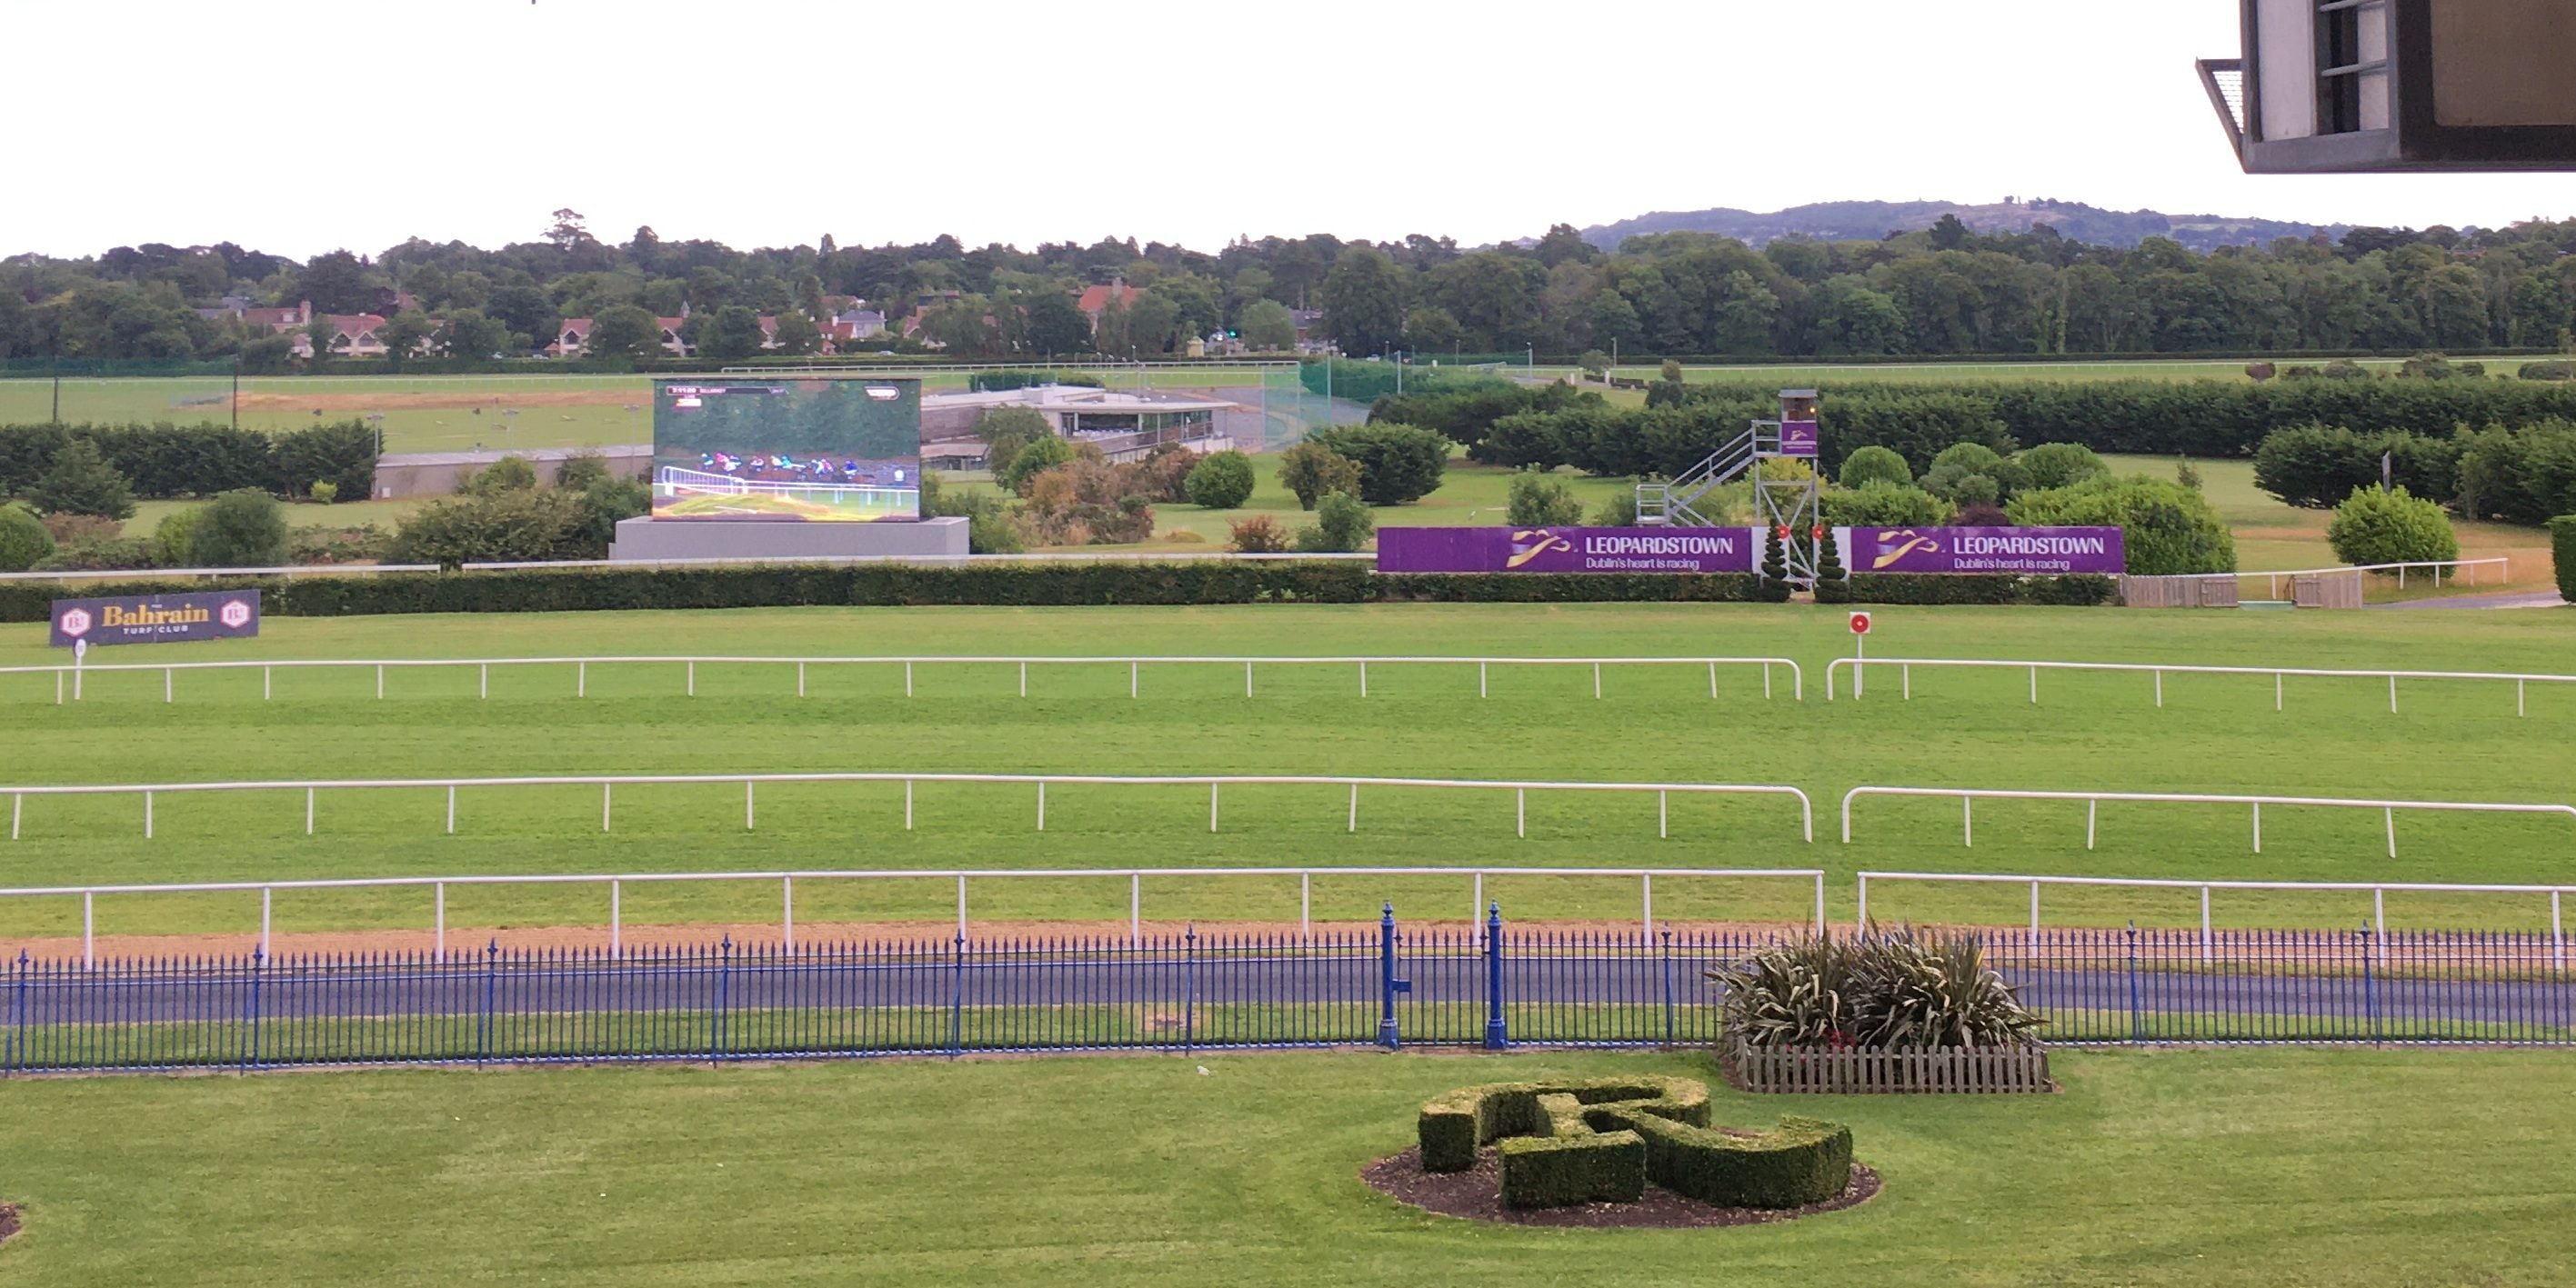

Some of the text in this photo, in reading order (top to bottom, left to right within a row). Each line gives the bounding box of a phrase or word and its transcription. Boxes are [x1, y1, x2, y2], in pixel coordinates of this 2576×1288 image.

[1586, 537, 1733, 554] LEOPARDSTOWN
[1954, 537, 2104, 554] LEOPARDSTOWN
[1586, 557, 1699, 571] Dublin's heart is racing
[1954, 557, 2070, 571] Dublin's heart is racing
[101, 603, 210, 627] Bahrain
[123, 624, 189, 634] TURF CLUB
